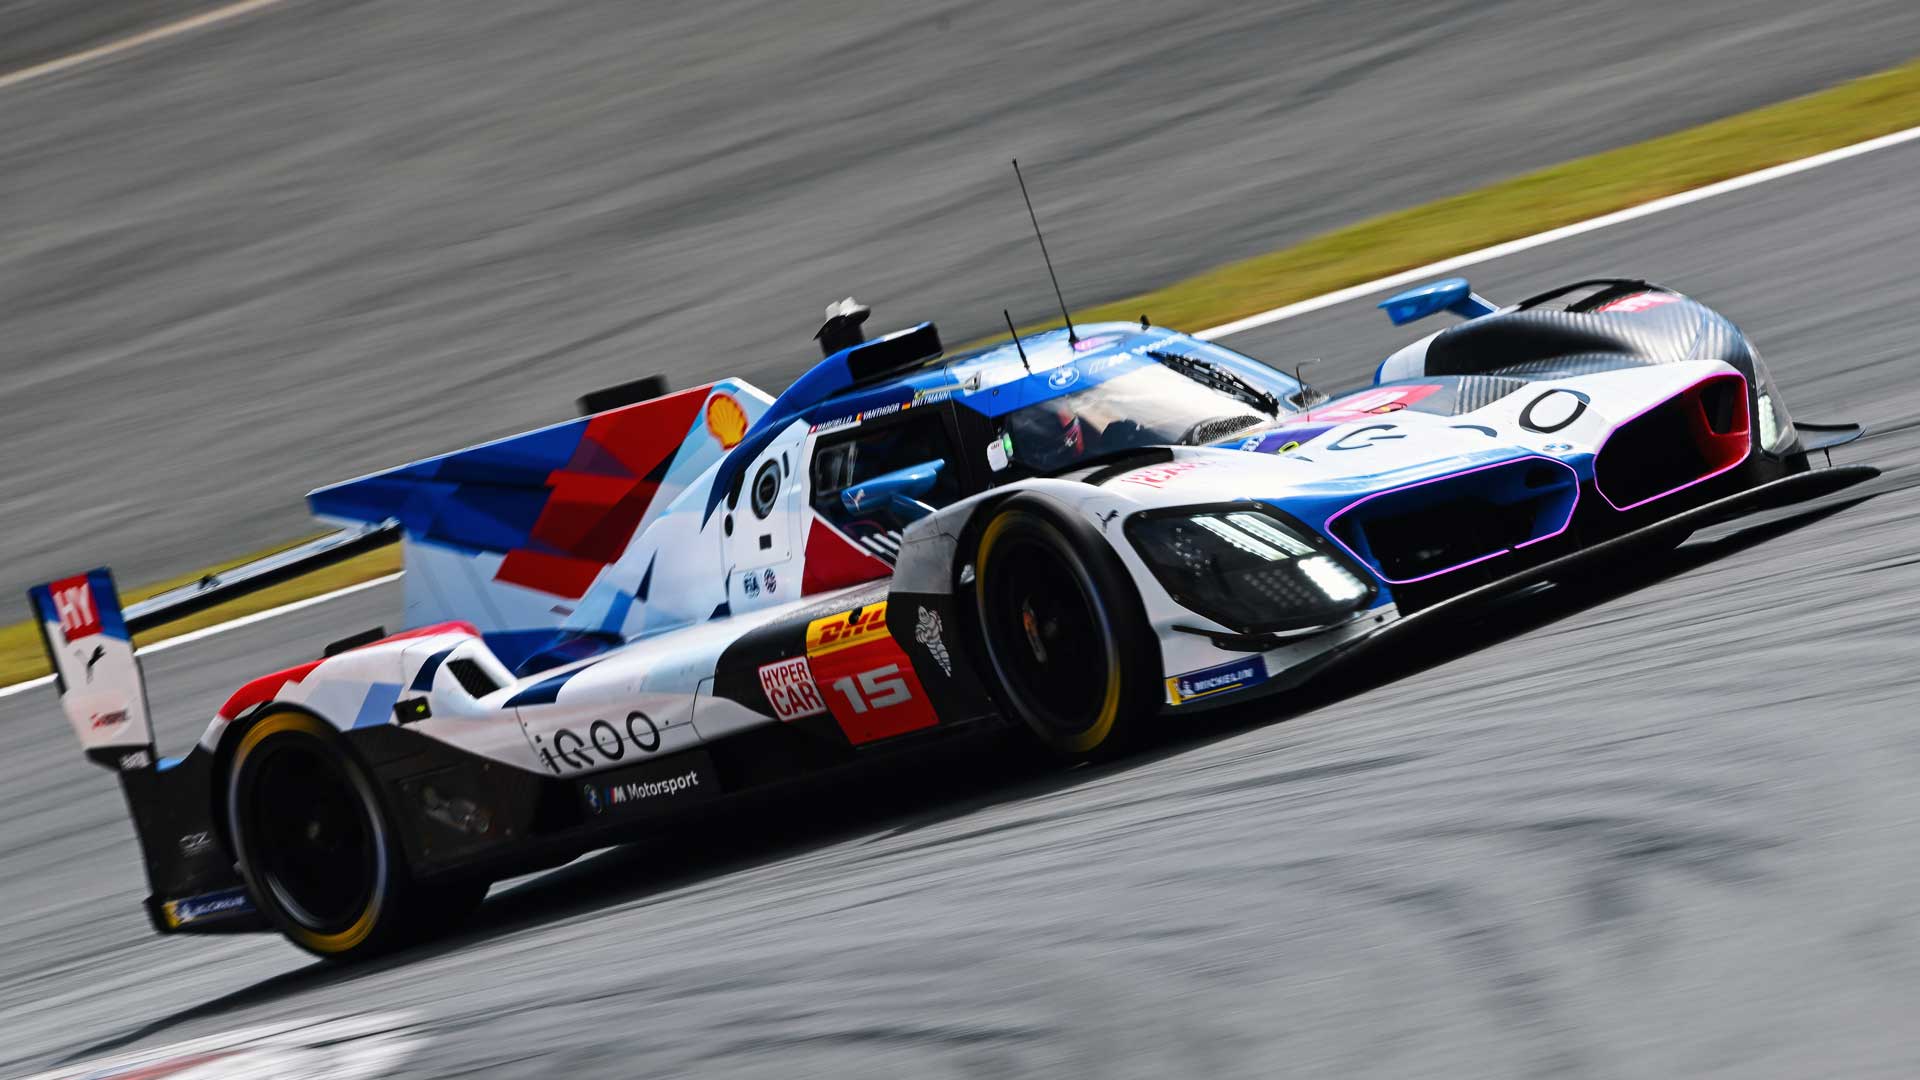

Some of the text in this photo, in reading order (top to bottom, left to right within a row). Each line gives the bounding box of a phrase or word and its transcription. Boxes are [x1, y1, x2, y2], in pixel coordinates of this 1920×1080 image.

[863, 402, 900, 420] VANTHOOR
[53, 583, 95, 631] HY
[819, 609, 886, 645] DHL
[762, 662, 809, 690] HYPER
[833, 663, 912, 714] 15
[769, 682, 822, 716] CAR
[627, 770, 699, 800] Motorsport
